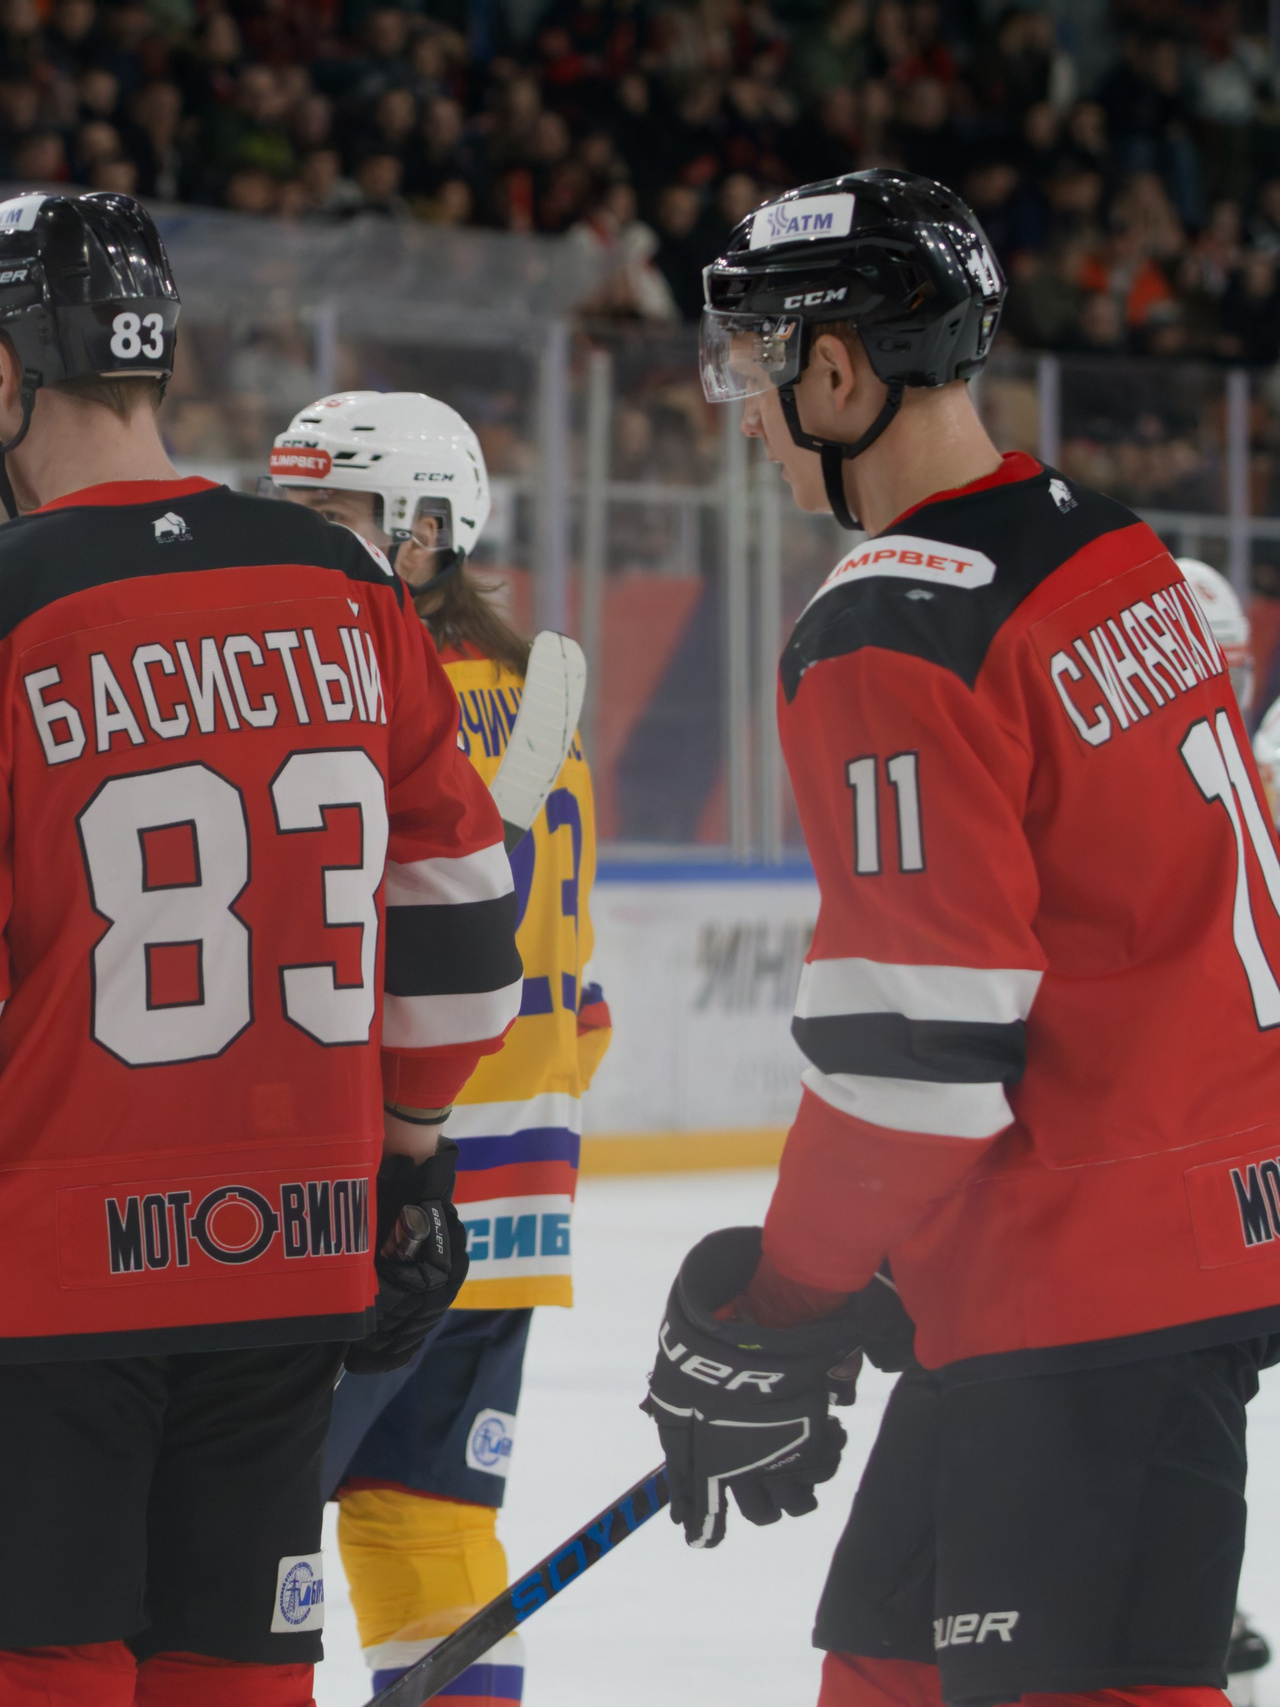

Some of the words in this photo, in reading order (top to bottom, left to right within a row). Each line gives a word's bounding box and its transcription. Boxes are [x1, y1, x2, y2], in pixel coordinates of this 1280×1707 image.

[783, 287, 848, 309] CCM
[110, 312, 164, 359] 83
[413, 472, 454, 482] CCM
[845, 750, 926, 876] 11
[75, 746, 389, 1070] 83
[1228, 1156, 1280, 1248] МО
[462, 1213, 570, 1261] СИБ
[511, 1468, 670, 1623] SOYU
[933, 1610, 1019, 1651] UER
